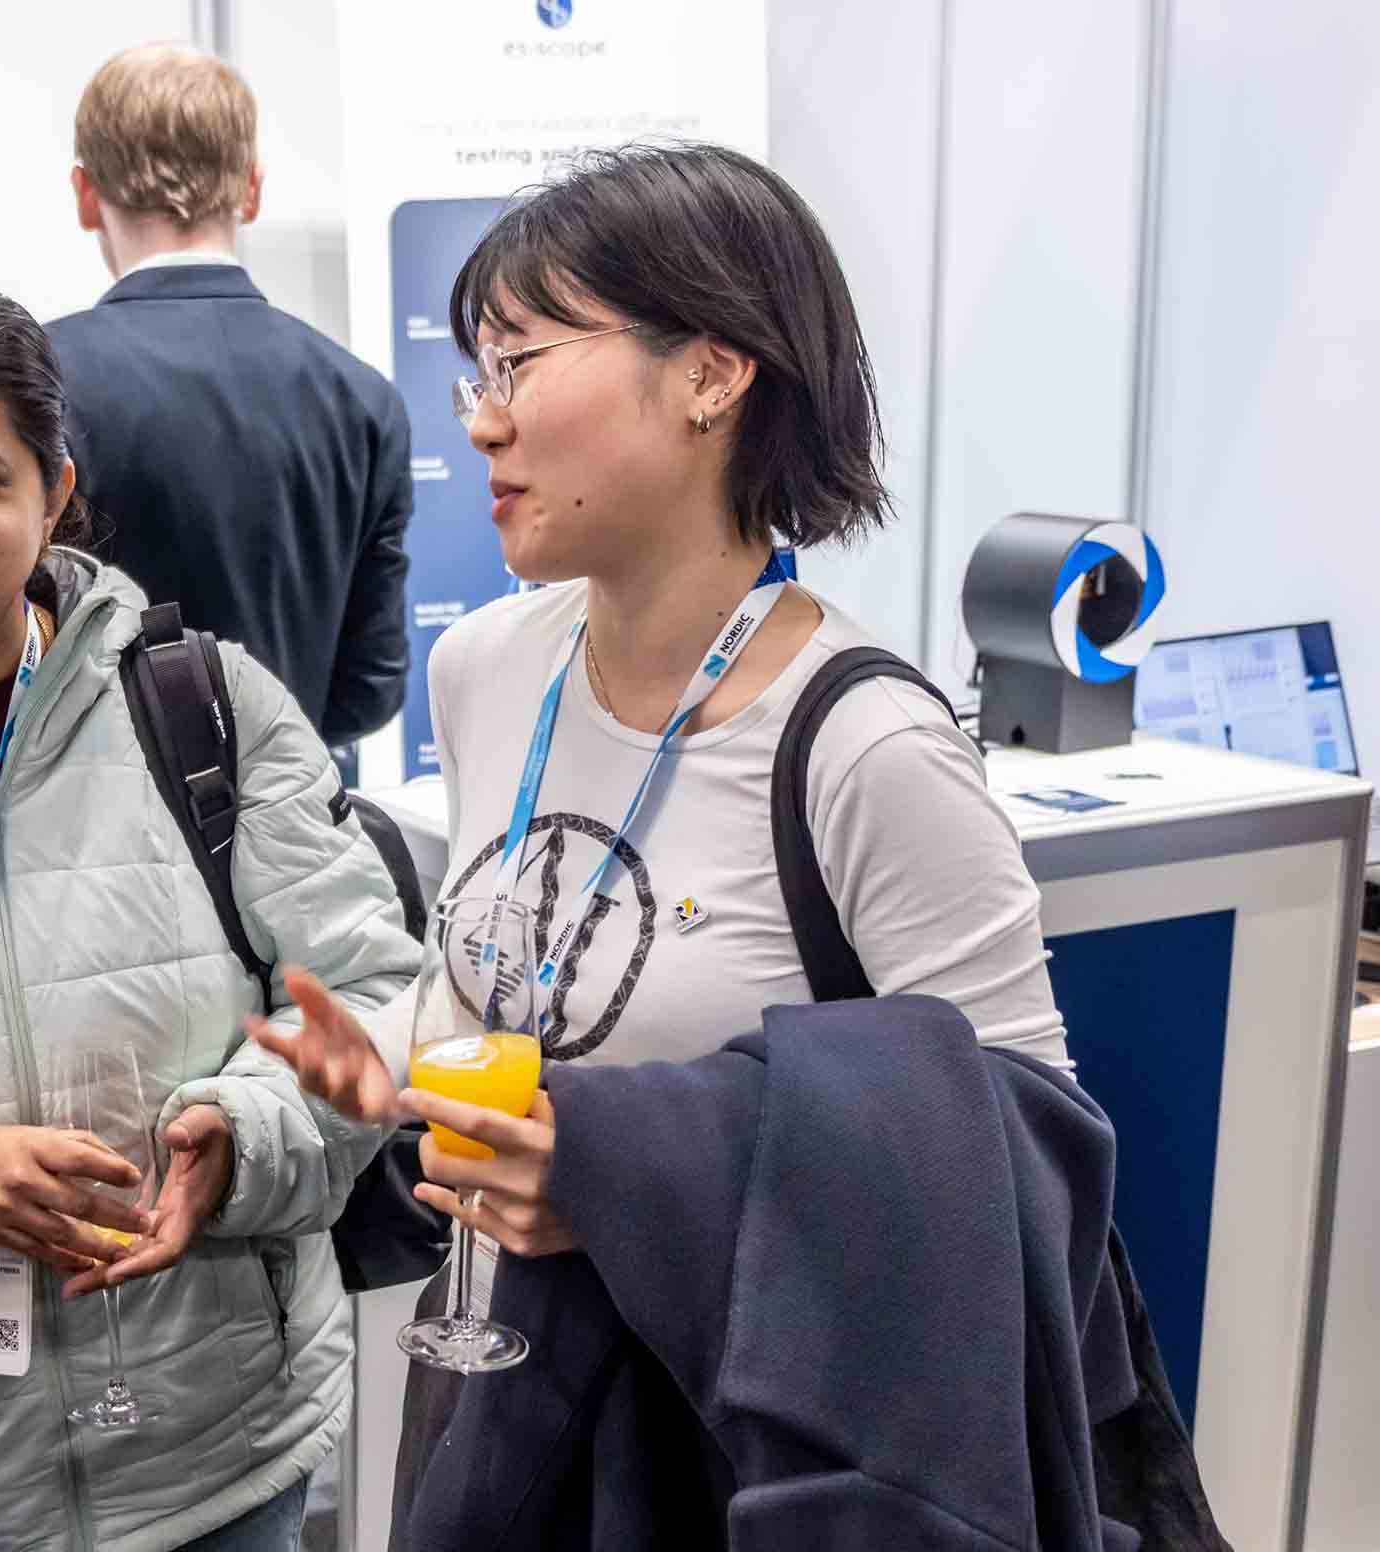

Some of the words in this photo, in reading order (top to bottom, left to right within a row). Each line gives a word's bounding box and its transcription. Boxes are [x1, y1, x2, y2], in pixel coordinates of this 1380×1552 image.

[455, 147, 532, 166] testing
[719, 612, 751, 653] NORDIC
[549, 919, 573, 961] NORDIC
